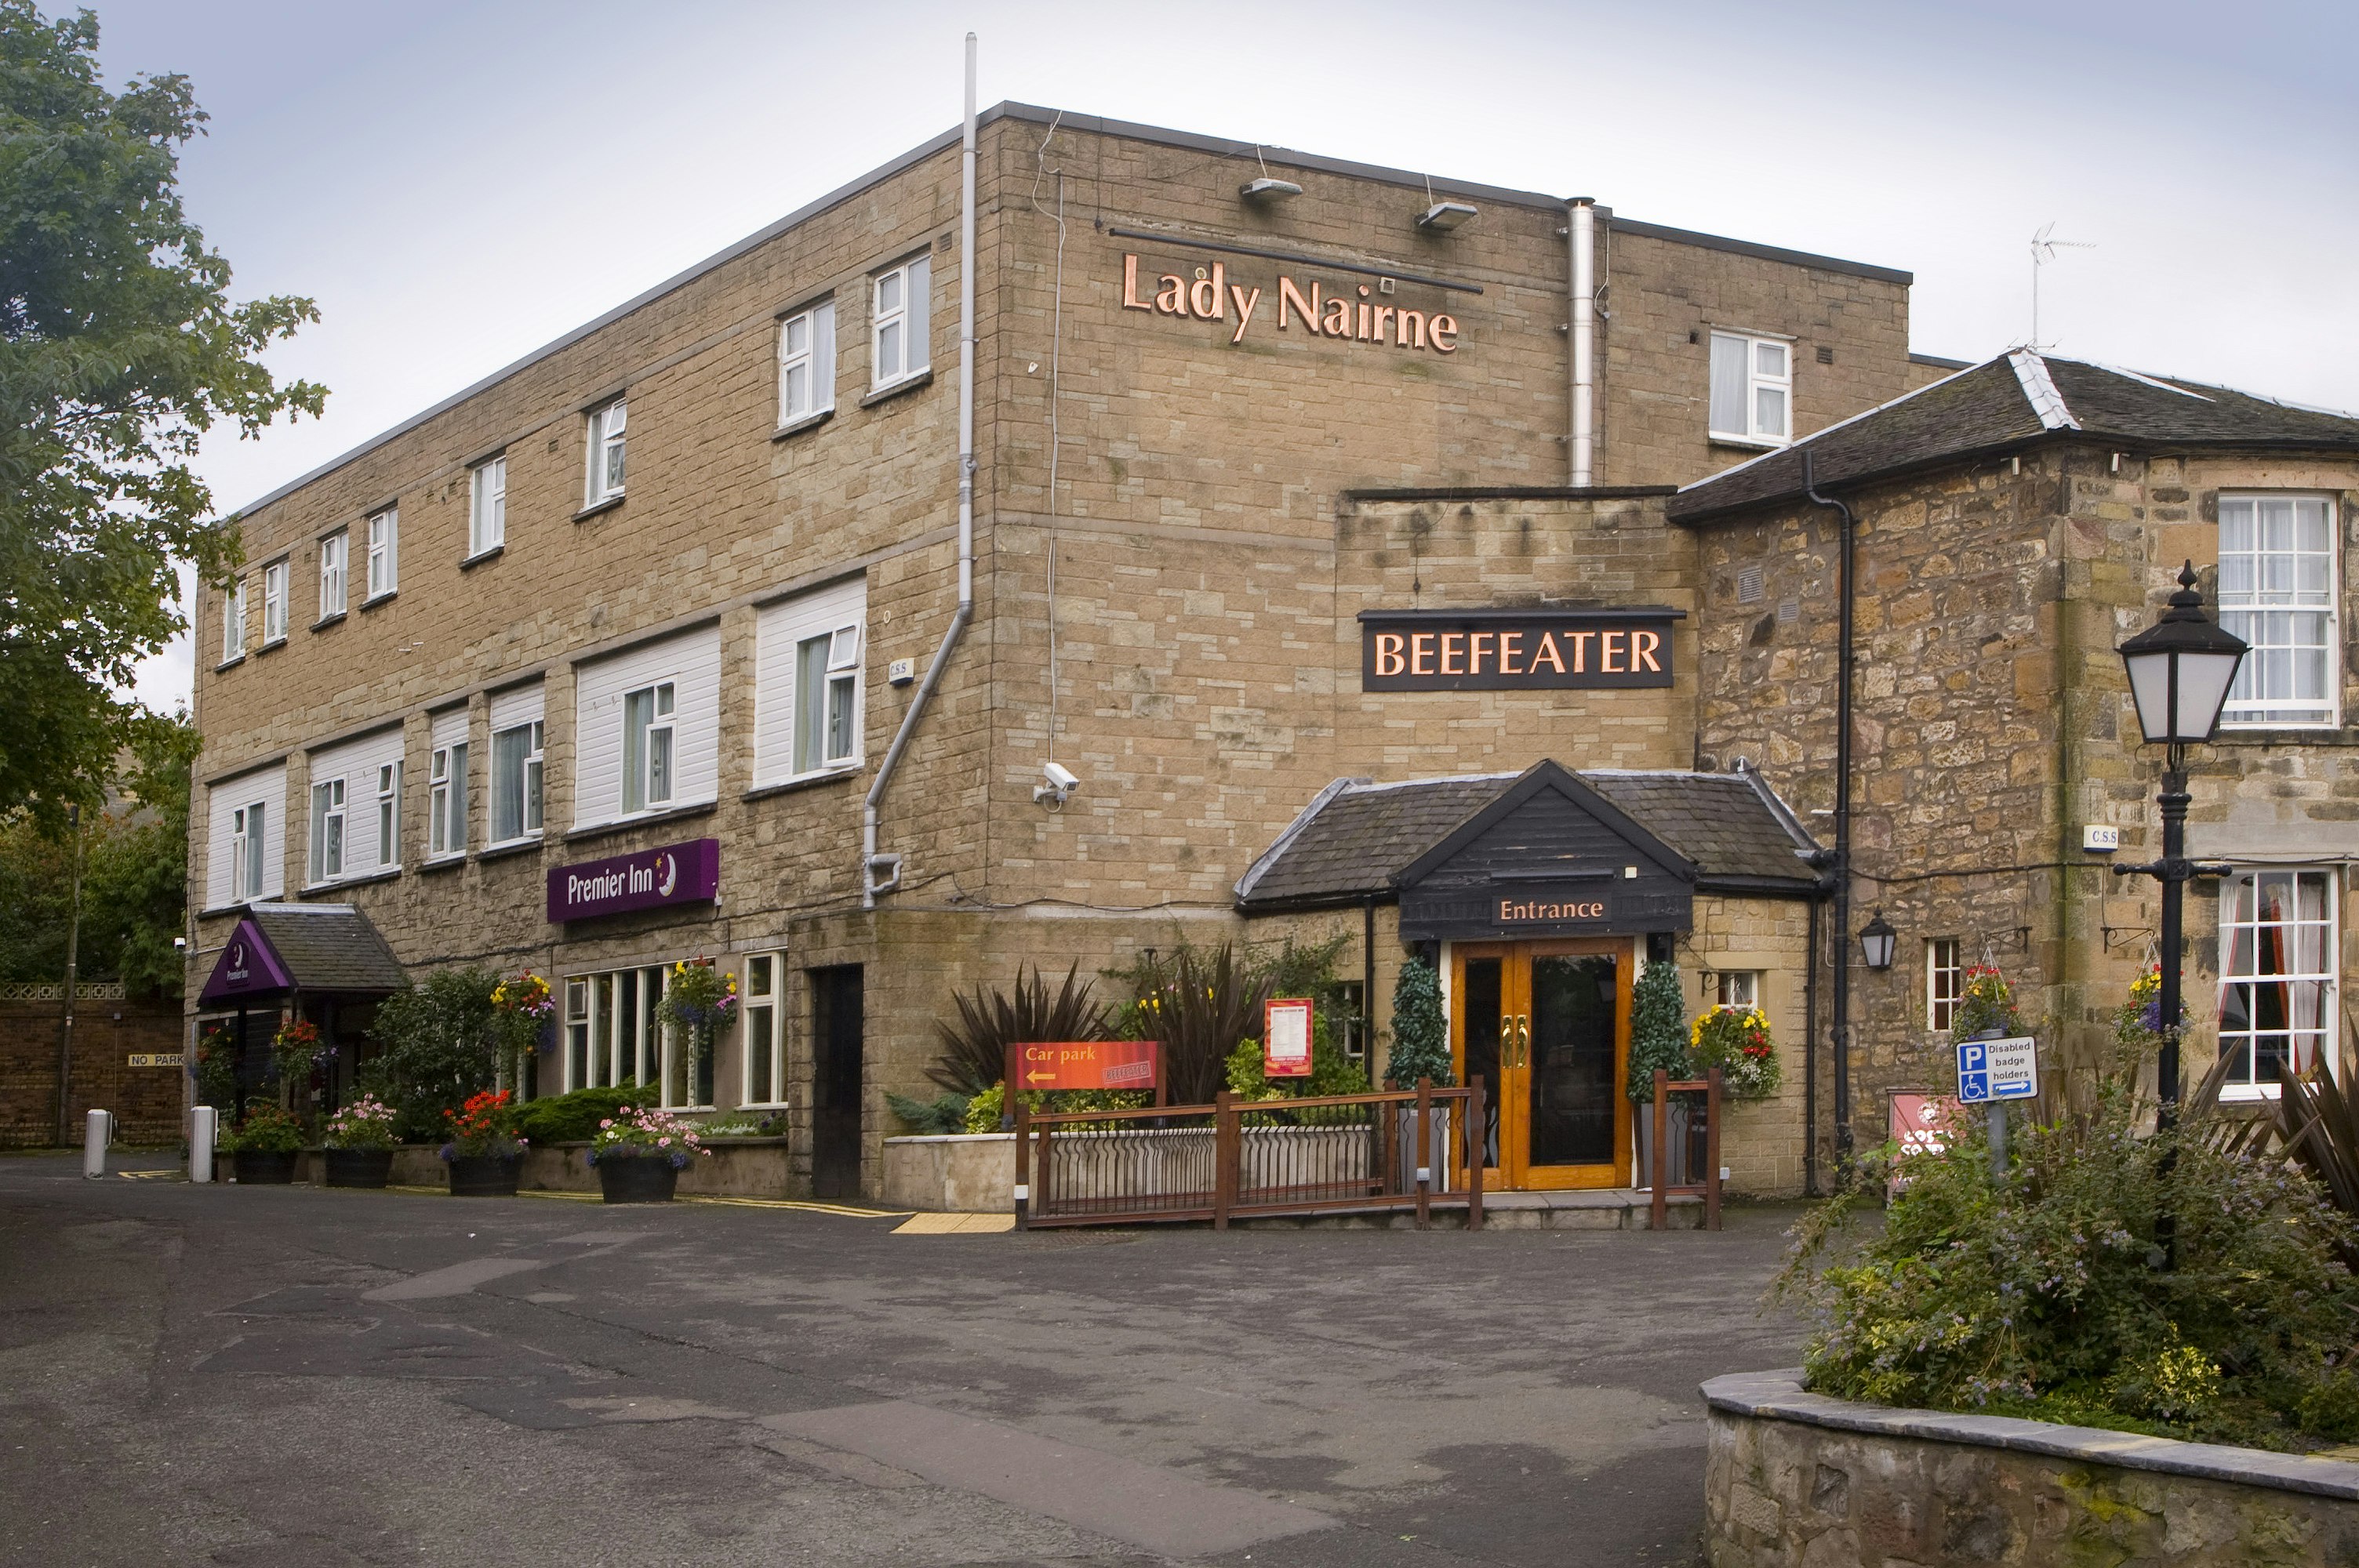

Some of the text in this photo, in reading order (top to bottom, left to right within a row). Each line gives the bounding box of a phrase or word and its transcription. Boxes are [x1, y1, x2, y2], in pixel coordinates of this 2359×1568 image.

[1124, 252, 1458, 354] Lady Nairne
[1376, 631, 1661, 676] BEEFEATER
[568, 863, 652, 905] Premier Inn
[1500, 900, 1603, 920] Entrance
[1025, 1046, 1096, 1065] Car park
[1988, 1042, 2030, 1054] Disabled
[132, 1055, 147, 1065] NO
[1995, 1058, 2026, 1068] badge
[1993, 1070, 2029, 1081] holders
